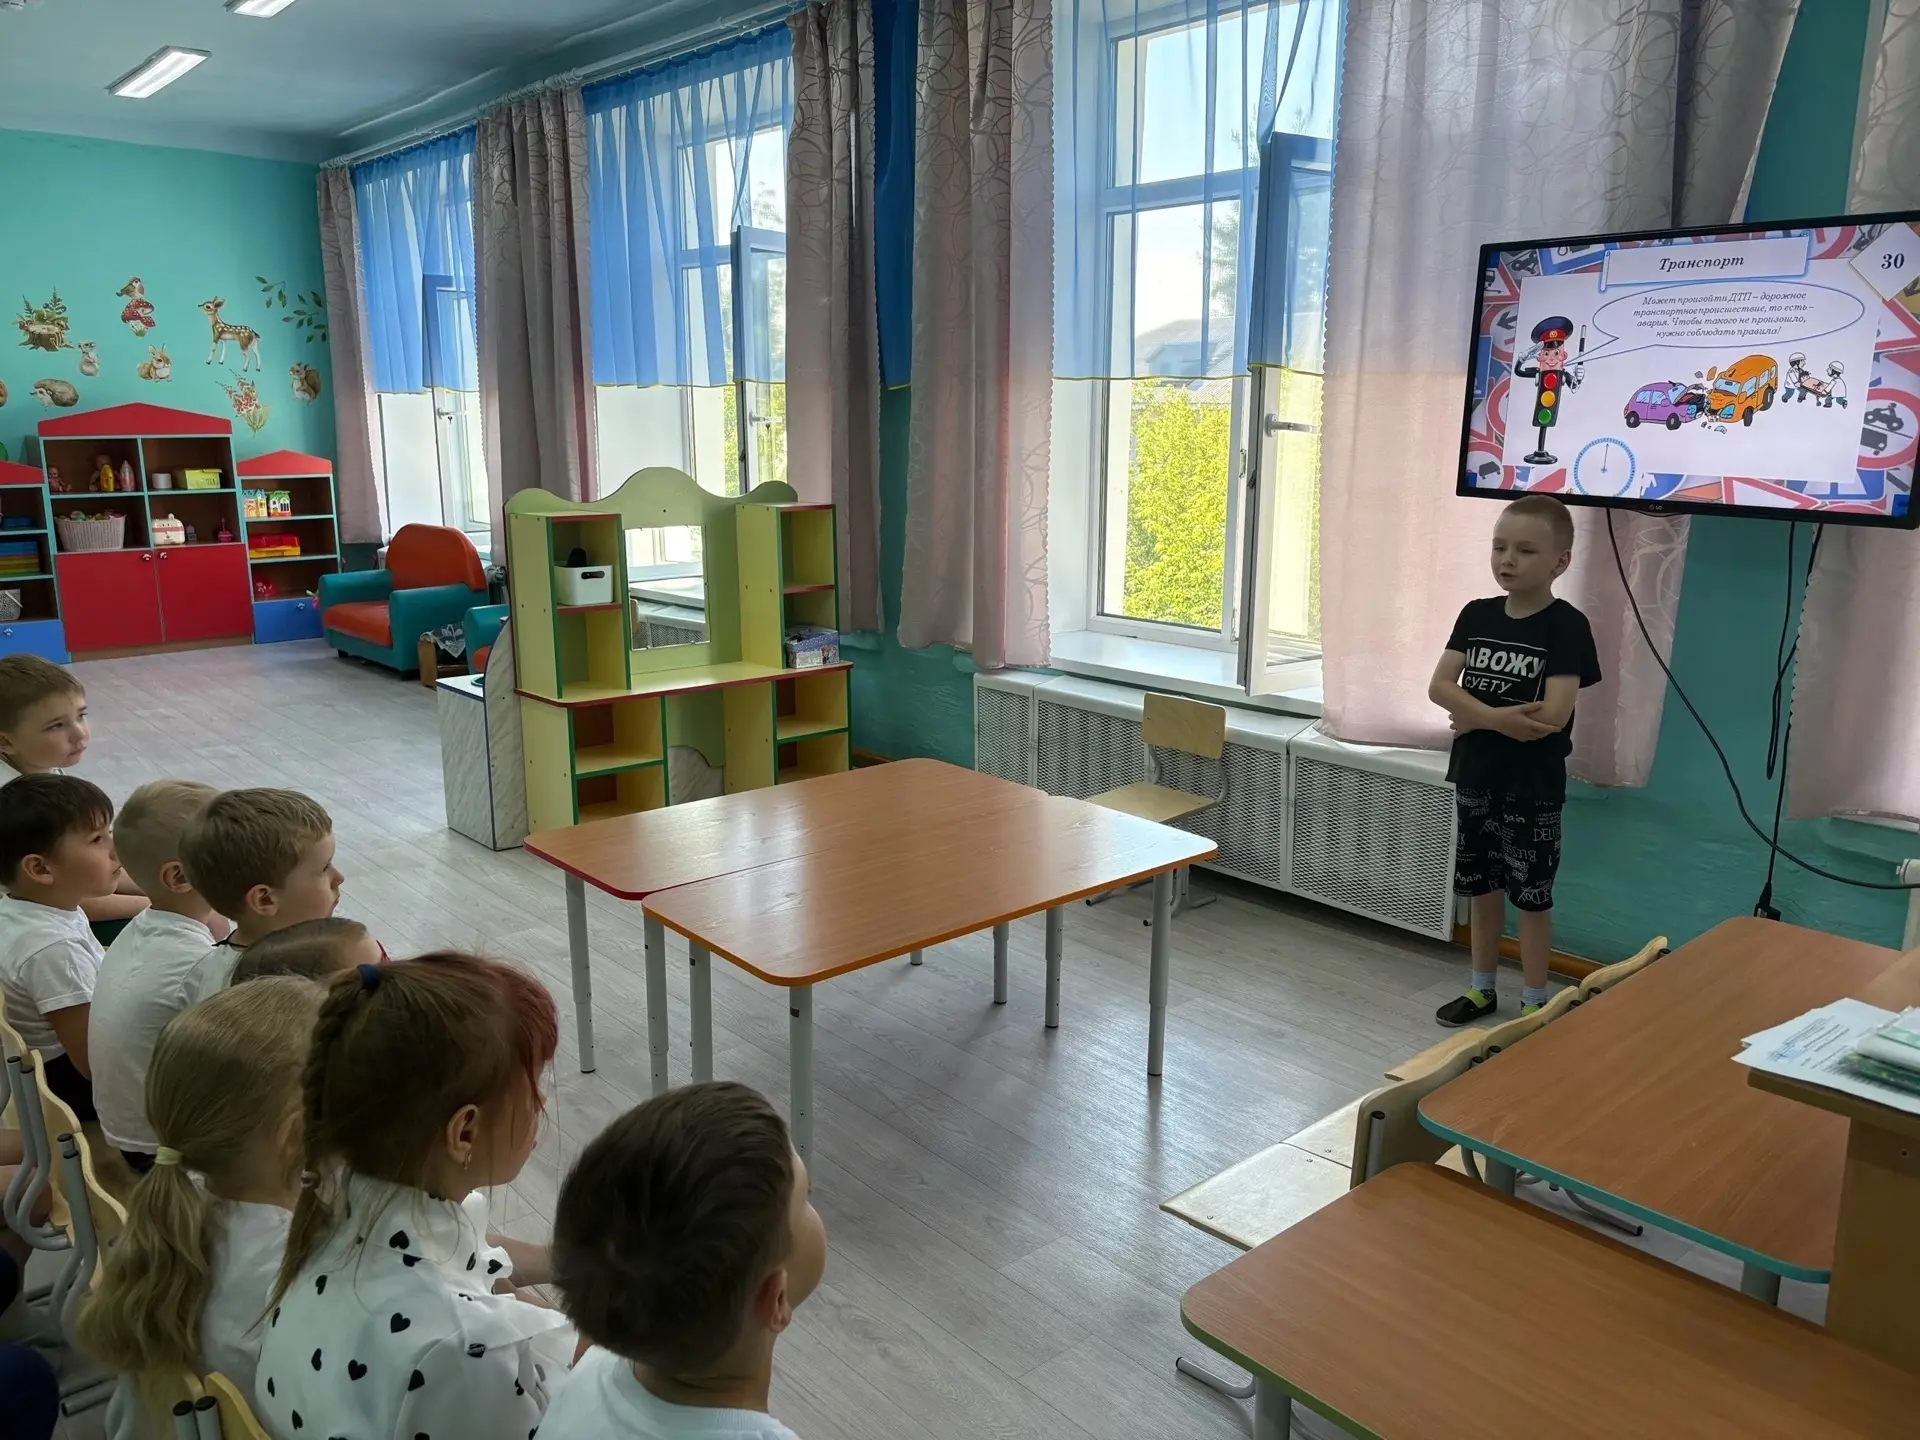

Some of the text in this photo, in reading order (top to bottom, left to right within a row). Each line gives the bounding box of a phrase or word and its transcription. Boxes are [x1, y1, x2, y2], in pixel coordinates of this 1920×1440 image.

[1658, 257, 1745, 272] Транспорт
[1881, 252, 1905, 270] 30
[1642, 296, 1676, 306] Может
[1677, 294, 1727, 306] произойти
[1727, 292, 1753, 303] ДТП
[1760, 291, 1807, 302] дорожное
[1633, 307, 1698, 318] транспортное
[1698, 305, 1767, 316] происшествие,
[1768, 304, 1782, 312] то
[1784, 304, 1807, 312] есть
[1636, 319, 1669, 328] авария.
[1672, 317, 1703, 326] Чтобы
[1704, 317, 1738, 325] такого
[1751, 315, 1806, 325] произошло,
[1656, 326, 1782, 338] нужно соблюдать правила!
[1464, 675, 1513, 694] СУЕТУ
[1455, 871, 1483, 885] Again
